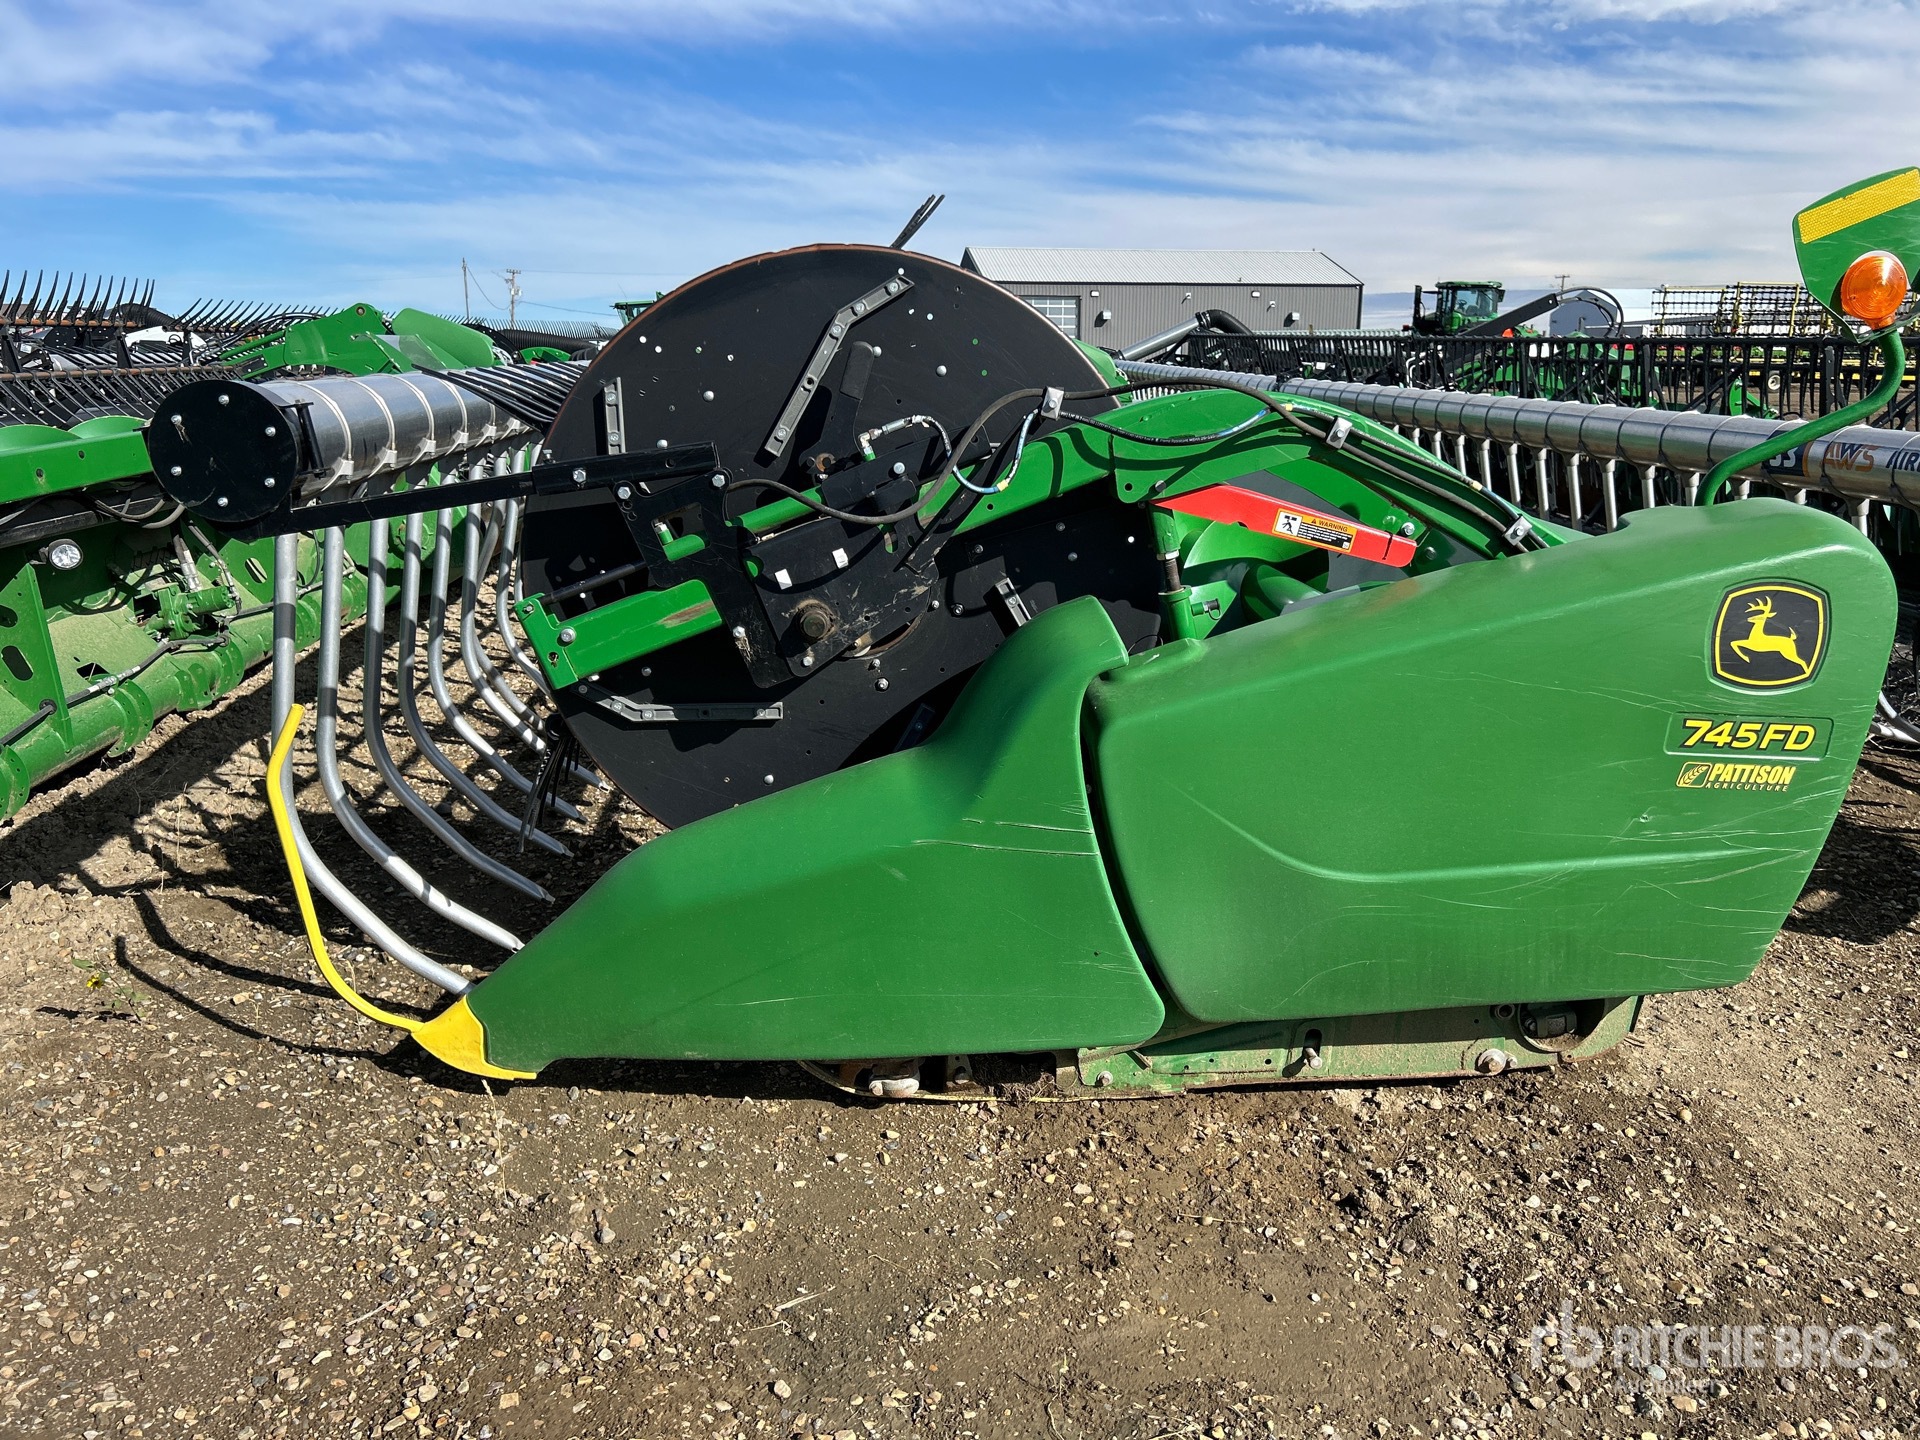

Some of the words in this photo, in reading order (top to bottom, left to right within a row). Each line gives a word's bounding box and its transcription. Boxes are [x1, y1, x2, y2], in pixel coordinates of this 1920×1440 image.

[1823, 442, 1879, 472] AWS
[1885, 450, 1920, 472] AIR
[1319, 519, 1348, 532] WARNING
[1680, 718, 1817, 751] 745FD
[1708, 763, 1797, 785] PATTISON
[1705, 781, 1789, 792] AGRICULTURE
